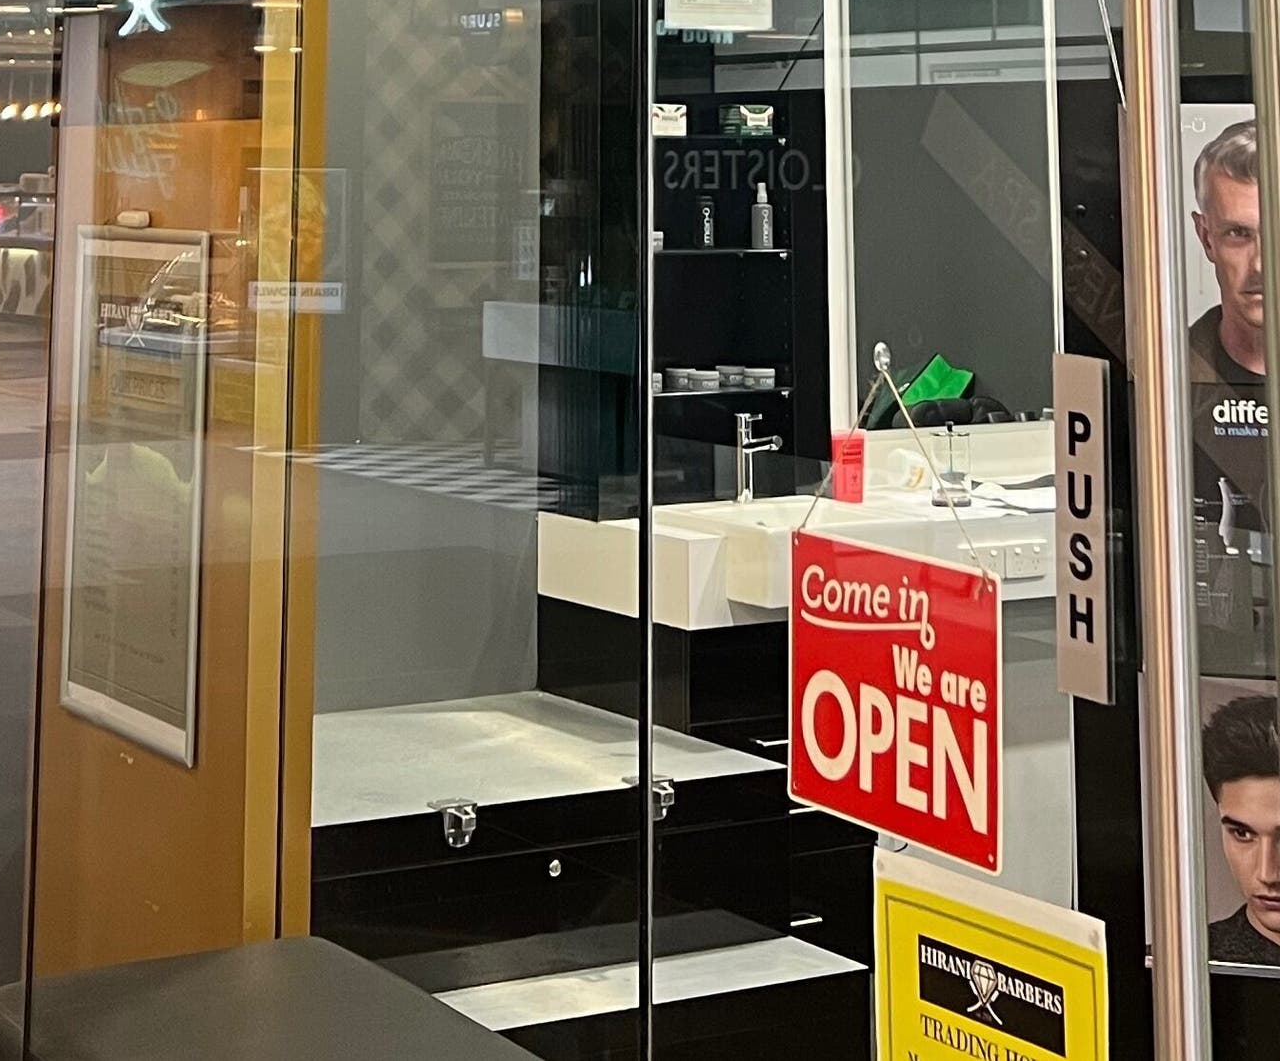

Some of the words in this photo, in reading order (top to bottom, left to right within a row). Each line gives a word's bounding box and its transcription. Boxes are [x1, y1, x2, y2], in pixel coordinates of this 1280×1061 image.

[1214, 426, 1225, 436] to
[1228, 426, 1258, 437] make
[1067, 411, 1094, 644] PUSH
[800, 564, 890, 619] Come
[898, 576, 935, 640] in
[892, 643, 933, 697] We
[940, 670, 988, 712] are
[800, 669, 988, 835] OPEN
[920, 944, 971, 980] HIRANI
[997, 971, 1063, 1015] BARBERS
[920, 1013, 1000, 1061] TRADING
